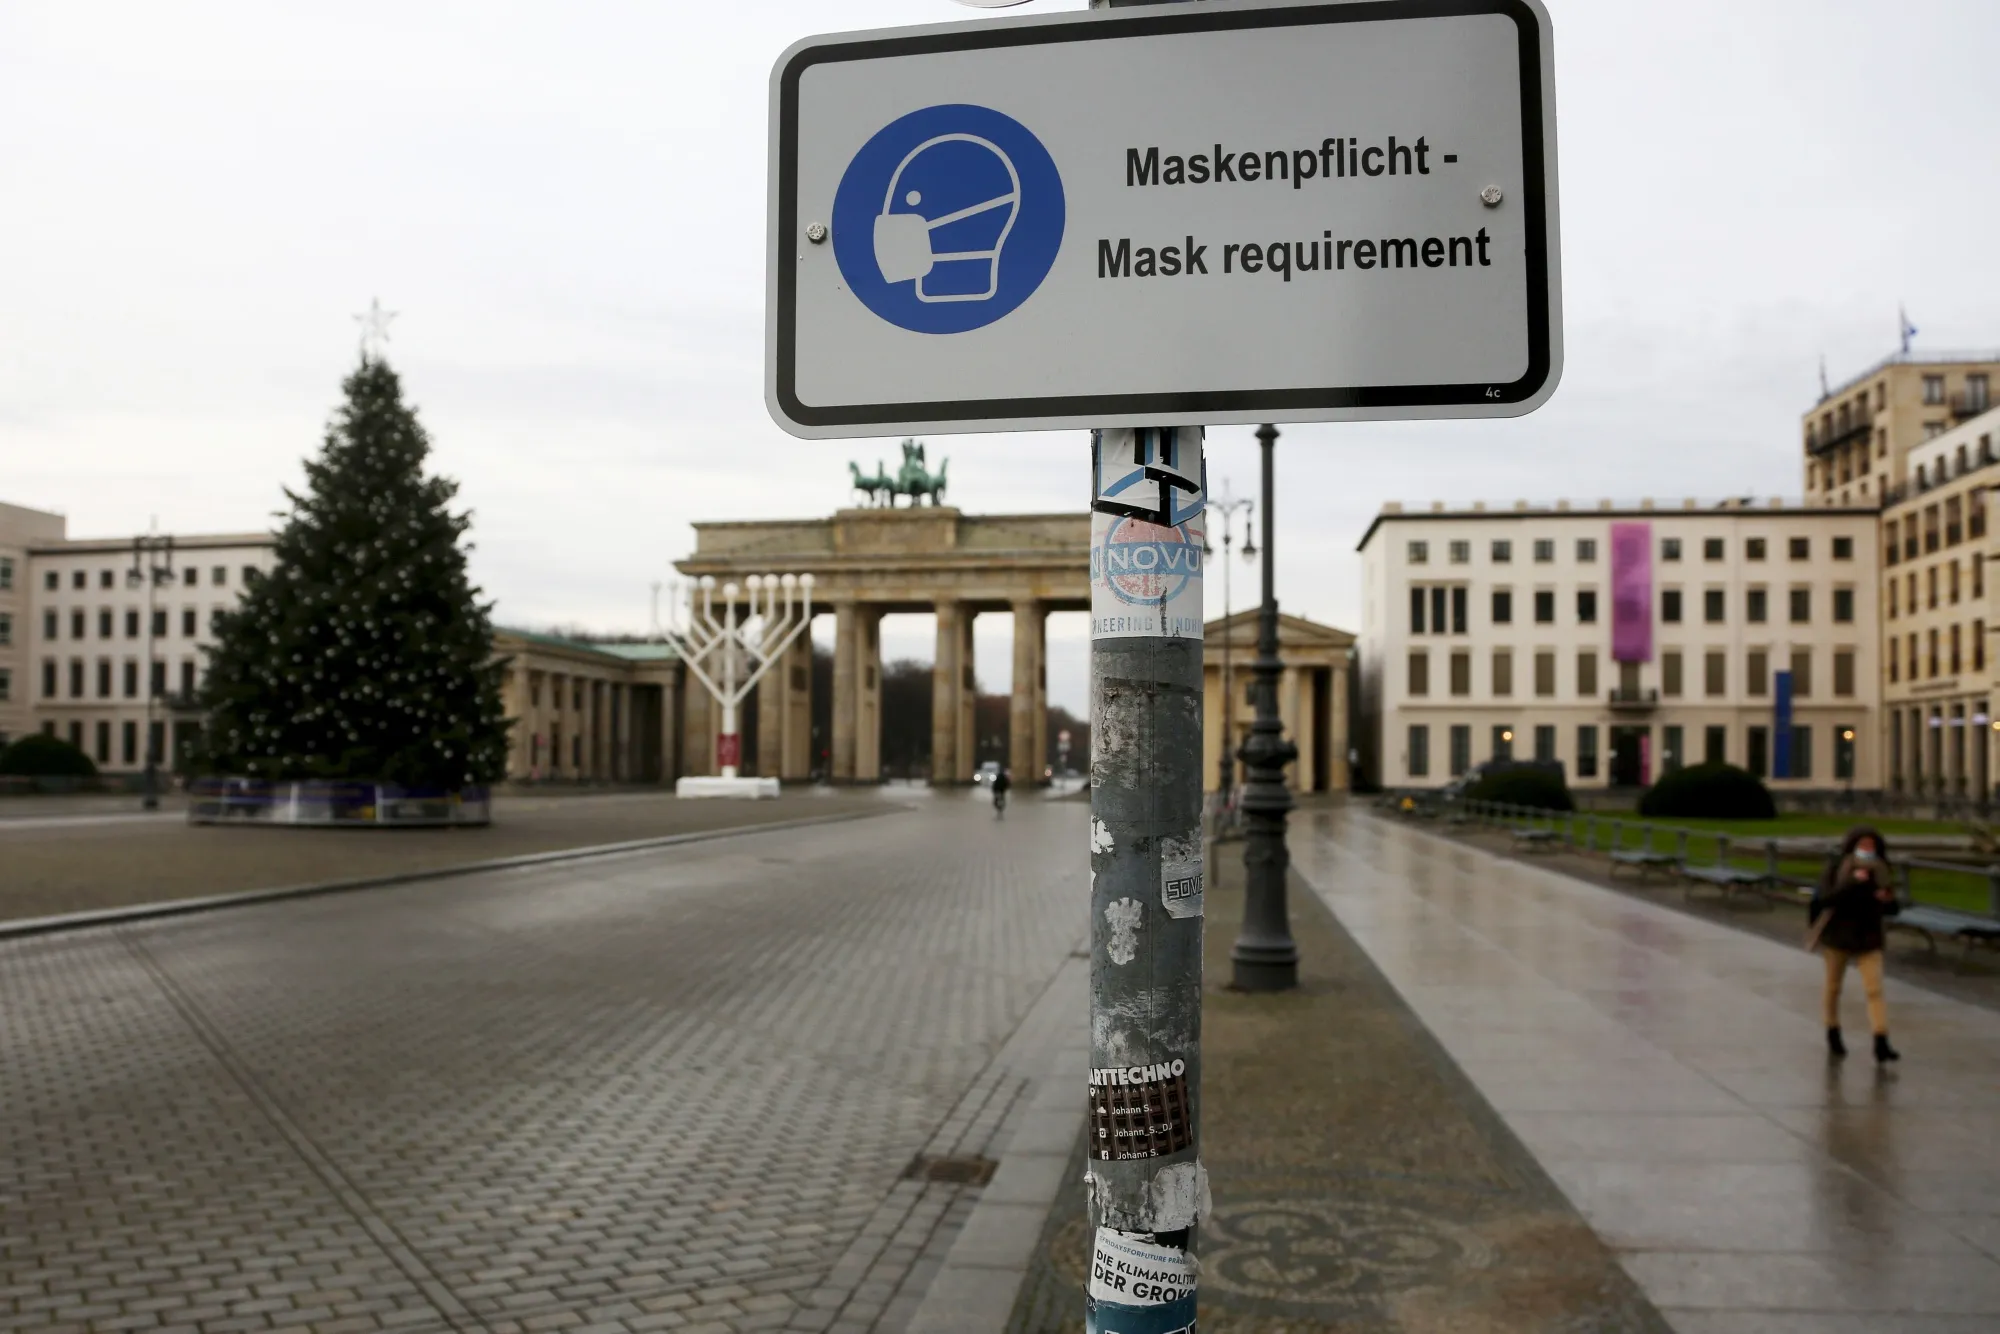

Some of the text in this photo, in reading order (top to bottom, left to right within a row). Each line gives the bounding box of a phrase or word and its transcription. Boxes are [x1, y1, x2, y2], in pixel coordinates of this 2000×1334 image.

[1126, 135, 1430, 189] Maskenpflicht
[1098, 227, 1491, 281] Mask requirement
[1108, 546, 1202, 572] NOVU
[1111, 1104, 1153, 1114] Johann S.
[1117, 1148, 1159, 1160] Johann S.
[1096, 1249, 1114, 1266] DIE
[1094, 1263, 1126, 1293] DER
